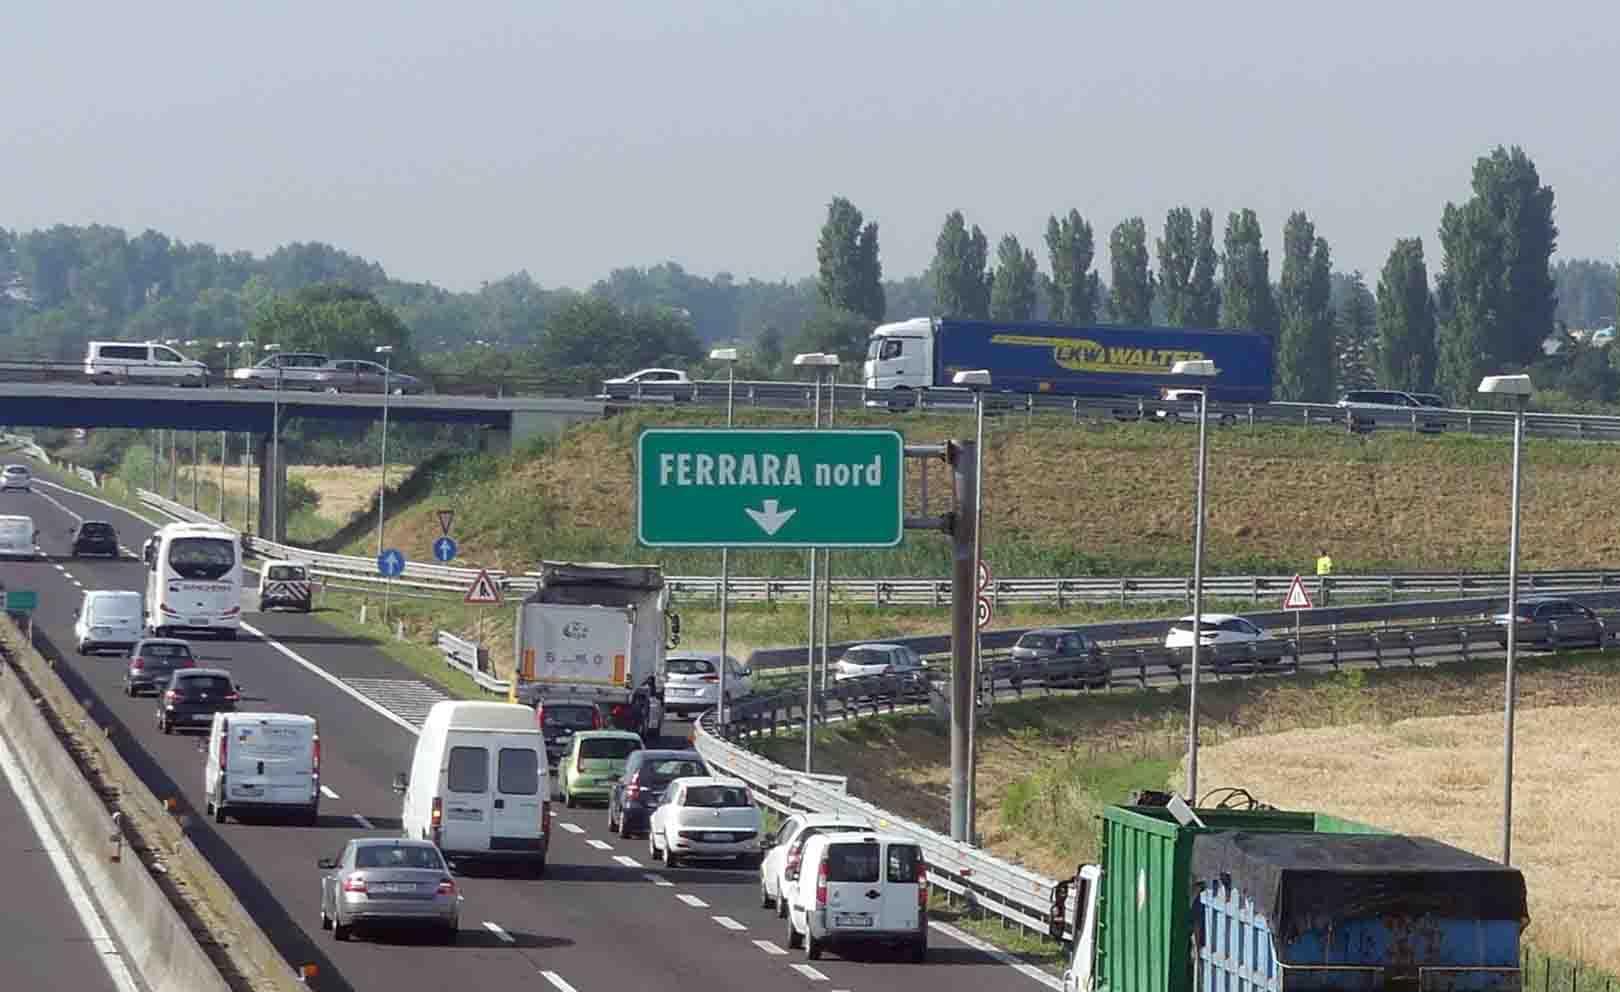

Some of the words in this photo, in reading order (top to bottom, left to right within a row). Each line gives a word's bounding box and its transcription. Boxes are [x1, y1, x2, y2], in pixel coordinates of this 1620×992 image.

[1108, 348, 1204, 366] WALTER
[659, 452, 802, 486] FERRARA
[815, 454, 881, 486] nord
